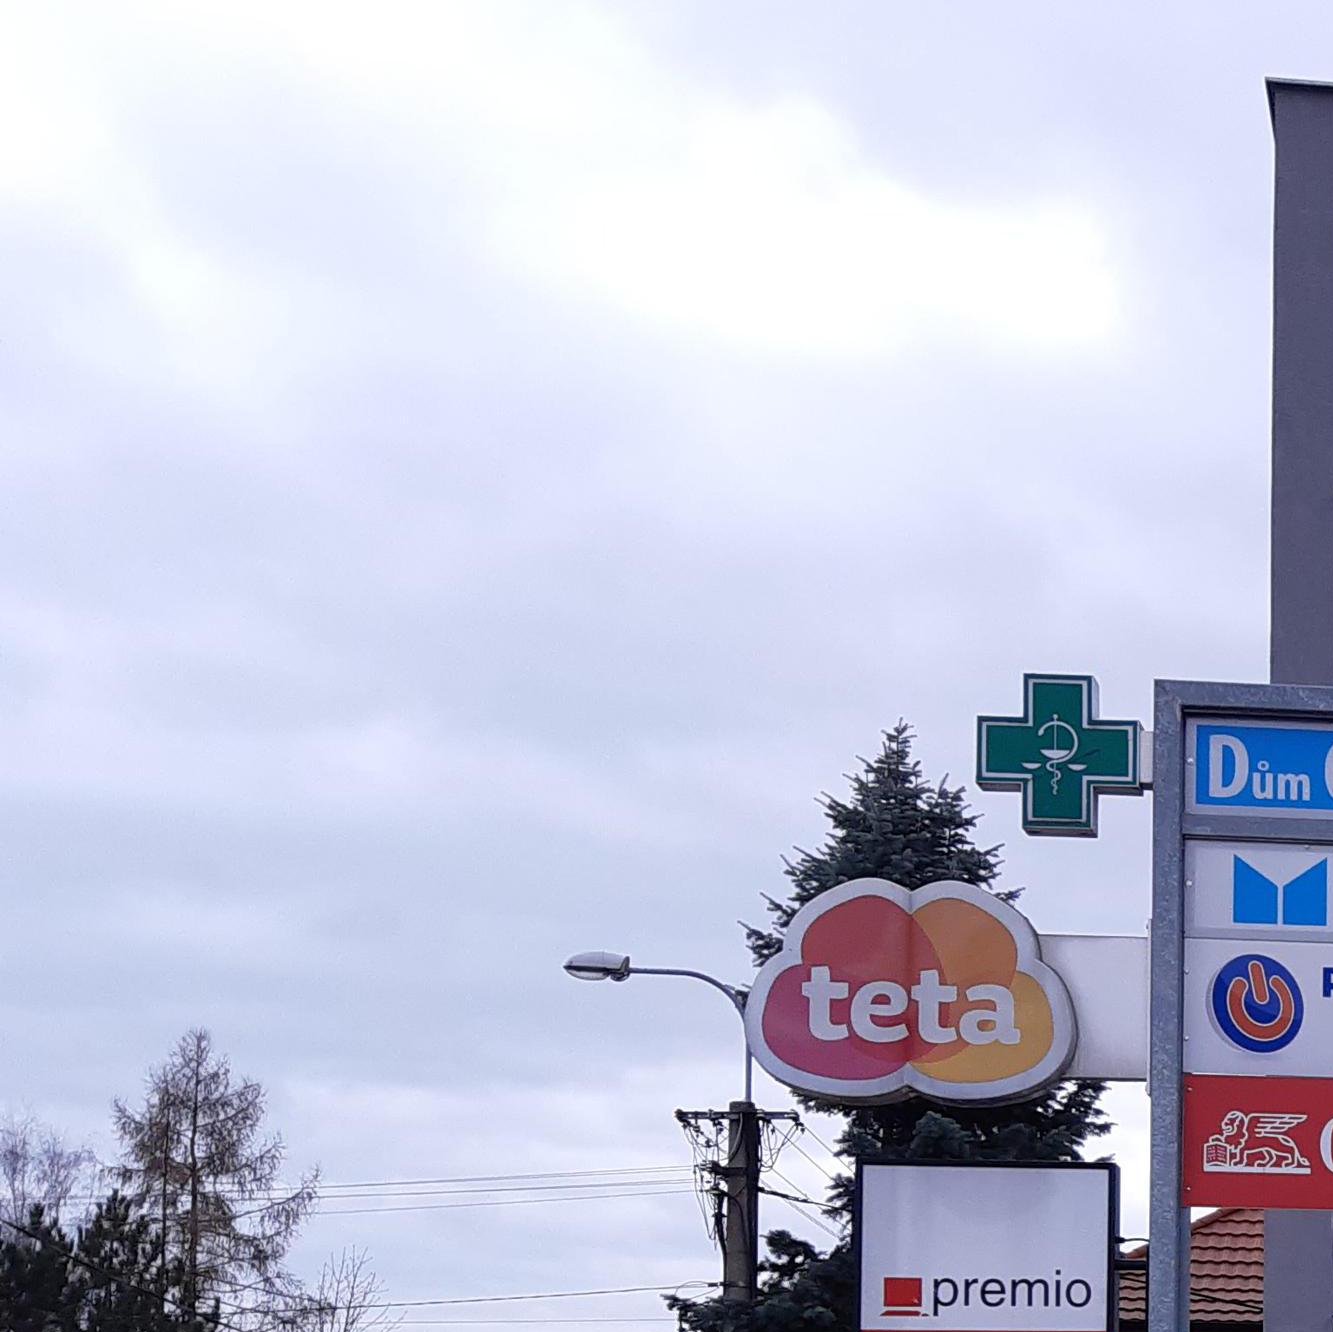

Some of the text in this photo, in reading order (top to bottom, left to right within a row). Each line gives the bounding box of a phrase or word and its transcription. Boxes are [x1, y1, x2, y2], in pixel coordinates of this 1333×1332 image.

[1208, 734, 1312, 801] Dům
[802, 965, 1021, 1047] teta
[932, 1270, 1093, 1317] premio
